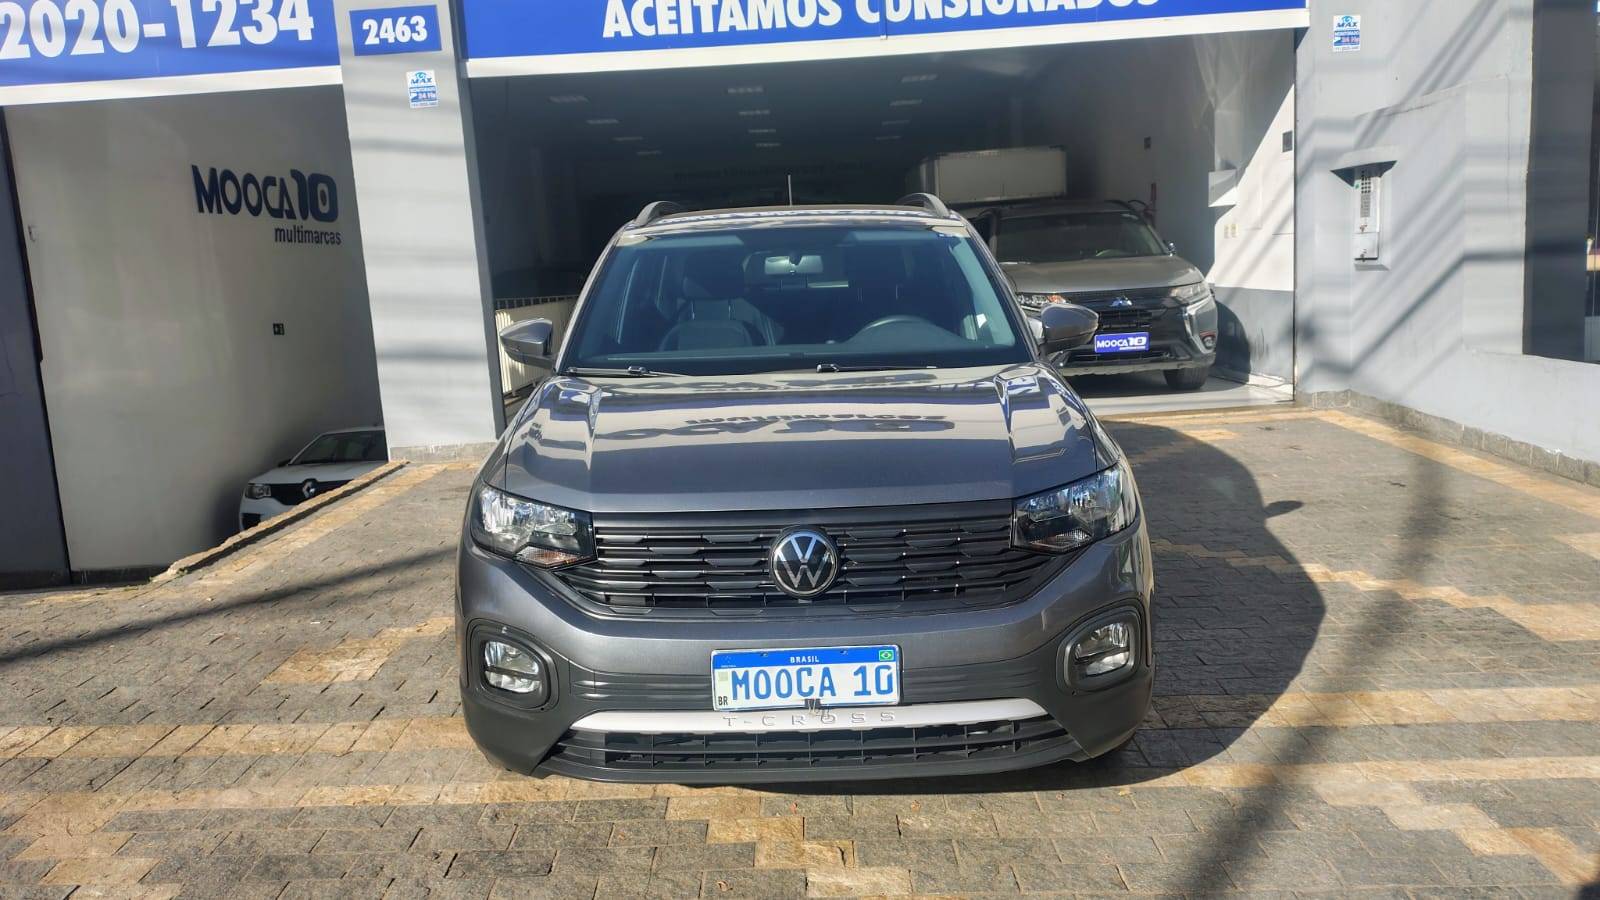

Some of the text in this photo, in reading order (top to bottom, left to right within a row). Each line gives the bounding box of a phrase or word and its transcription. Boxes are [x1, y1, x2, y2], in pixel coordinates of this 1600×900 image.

[0, 0, 314, 60] 2020-1234
[362, 15, 428, 45] 2463
[602, 0, 842, 38] ACEITAMOS
[274, 225, 342, 245] multimarcas
[790, 655, 820, 664] BRASIL
[731, 667, 837, 701] MOOCA
[717, 696, 729, 706] BR
[722, 711, 895, 728] T-CROSS
